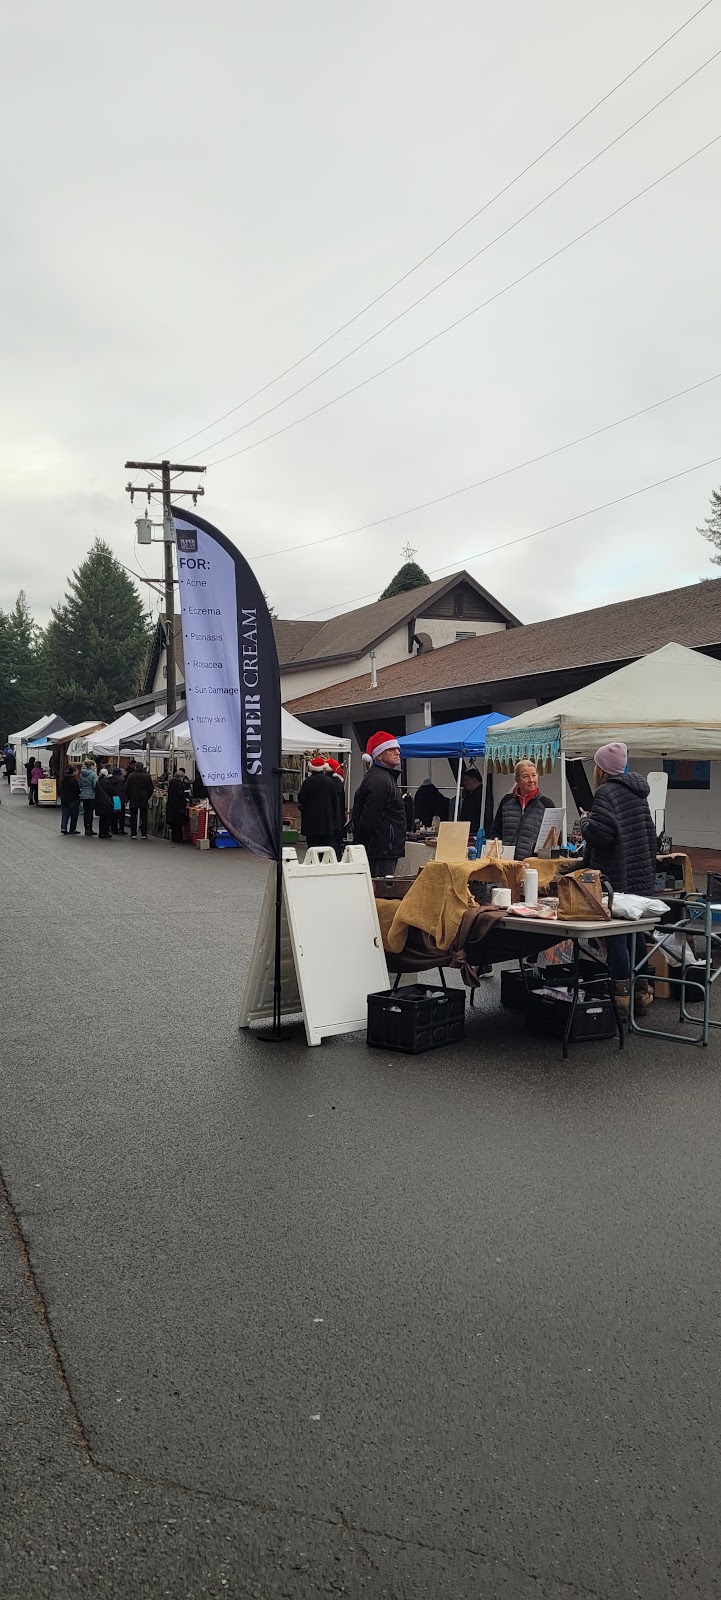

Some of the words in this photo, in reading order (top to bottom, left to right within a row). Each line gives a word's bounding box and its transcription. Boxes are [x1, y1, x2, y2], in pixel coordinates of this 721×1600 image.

[179, 557, 211, 570] FOR:
[186, 578, 207, 588] Acne
[188, 606, 221, 616] Eczema
[190, 632, 223, 642] Psoriasis
[242, 608, 258, 688] CREAM
[193, 660, 223, 669] Rosacea
[194, 686, 207, 694] Sun
[208, 686, 239, 696] Damage
[196, 716, 213, 725] Itchy
[246, 695, 262, 775] SUPER
[202, 744, 222, 753] Scalp
[207, 772, 225, 781] Aging
[226, 771, 239, 779] skin
